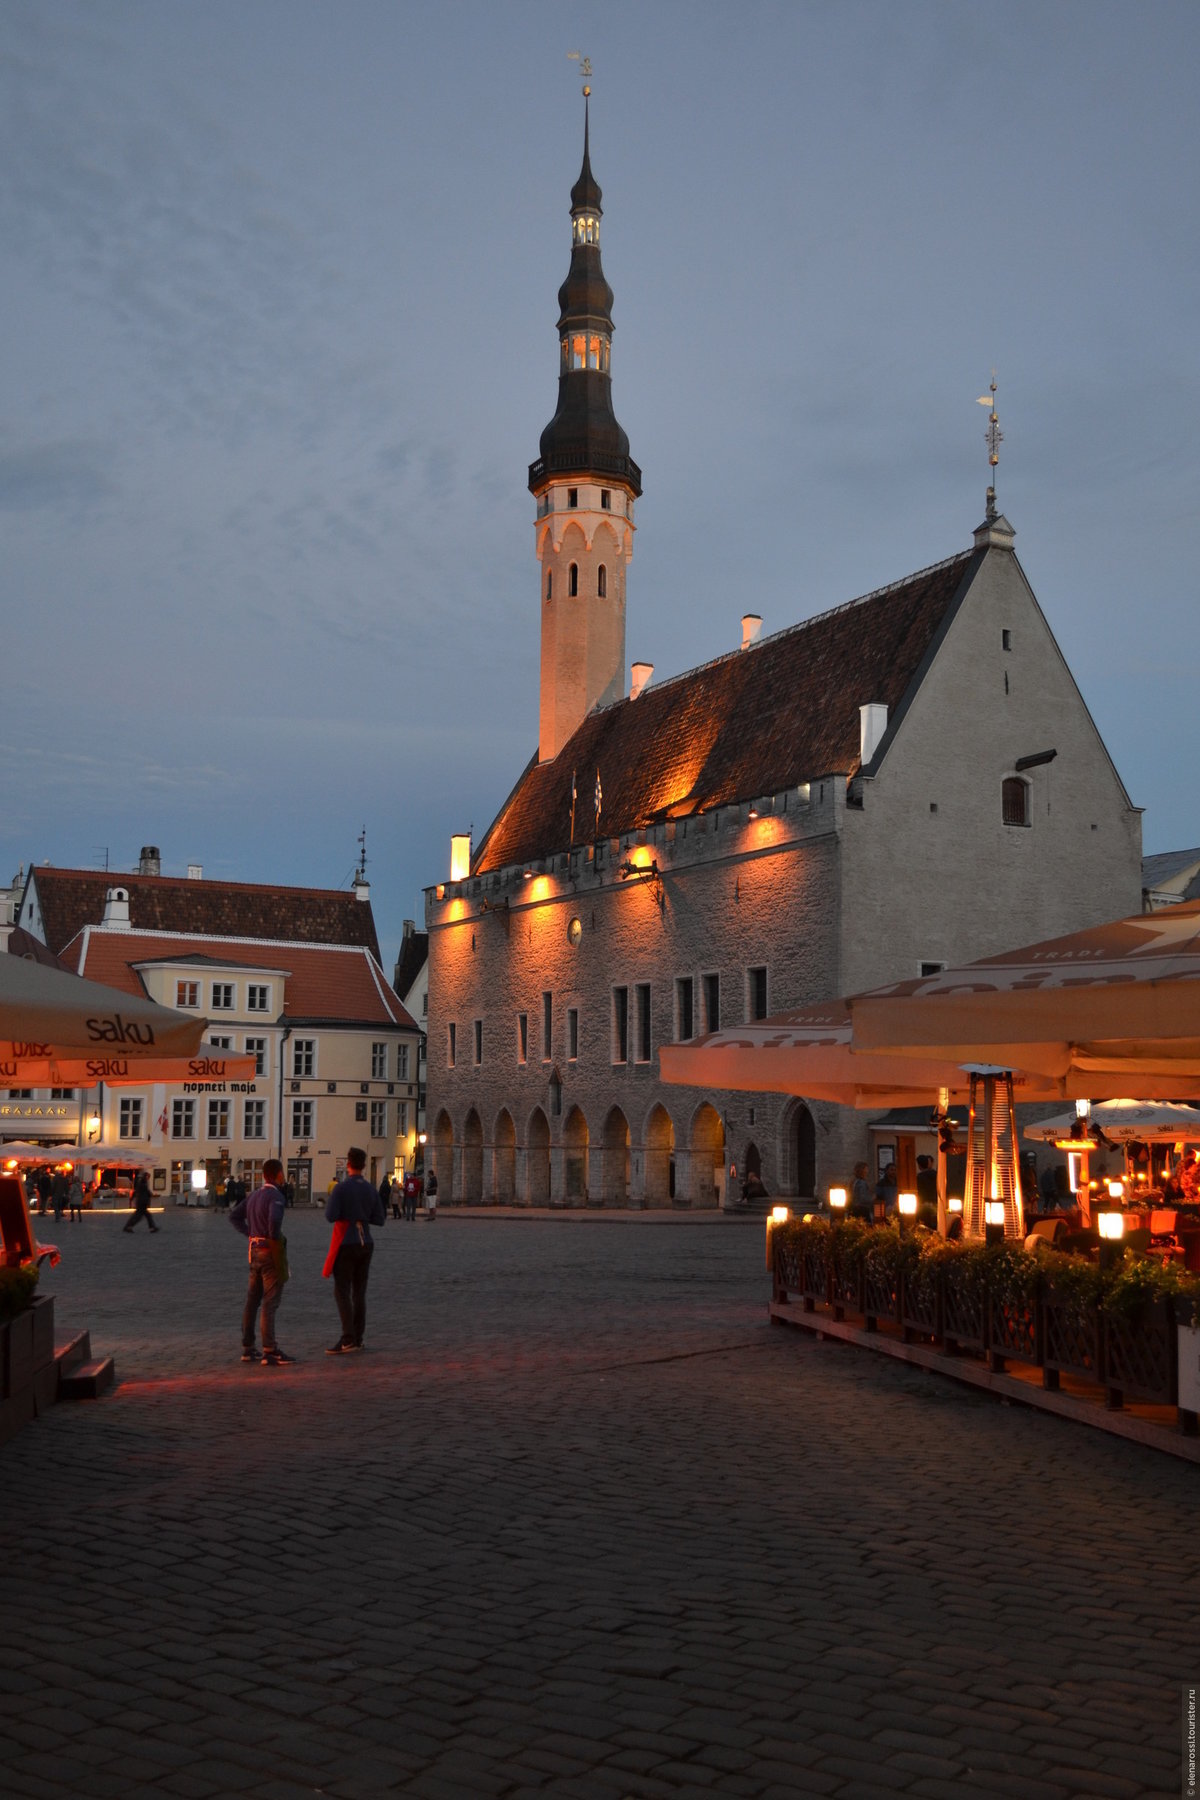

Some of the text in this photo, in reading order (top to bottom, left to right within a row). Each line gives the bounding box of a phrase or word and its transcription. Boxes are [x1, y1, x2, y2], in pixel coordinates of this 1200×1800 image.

[1031, 948, 1106, 960] TRADE
[86, 1014, 155, 1045] saku
[86, 1058, 129, 1077] saku
[188, 1057, 226, 1076] saku
[230, 1081, 257, 1095] maja
